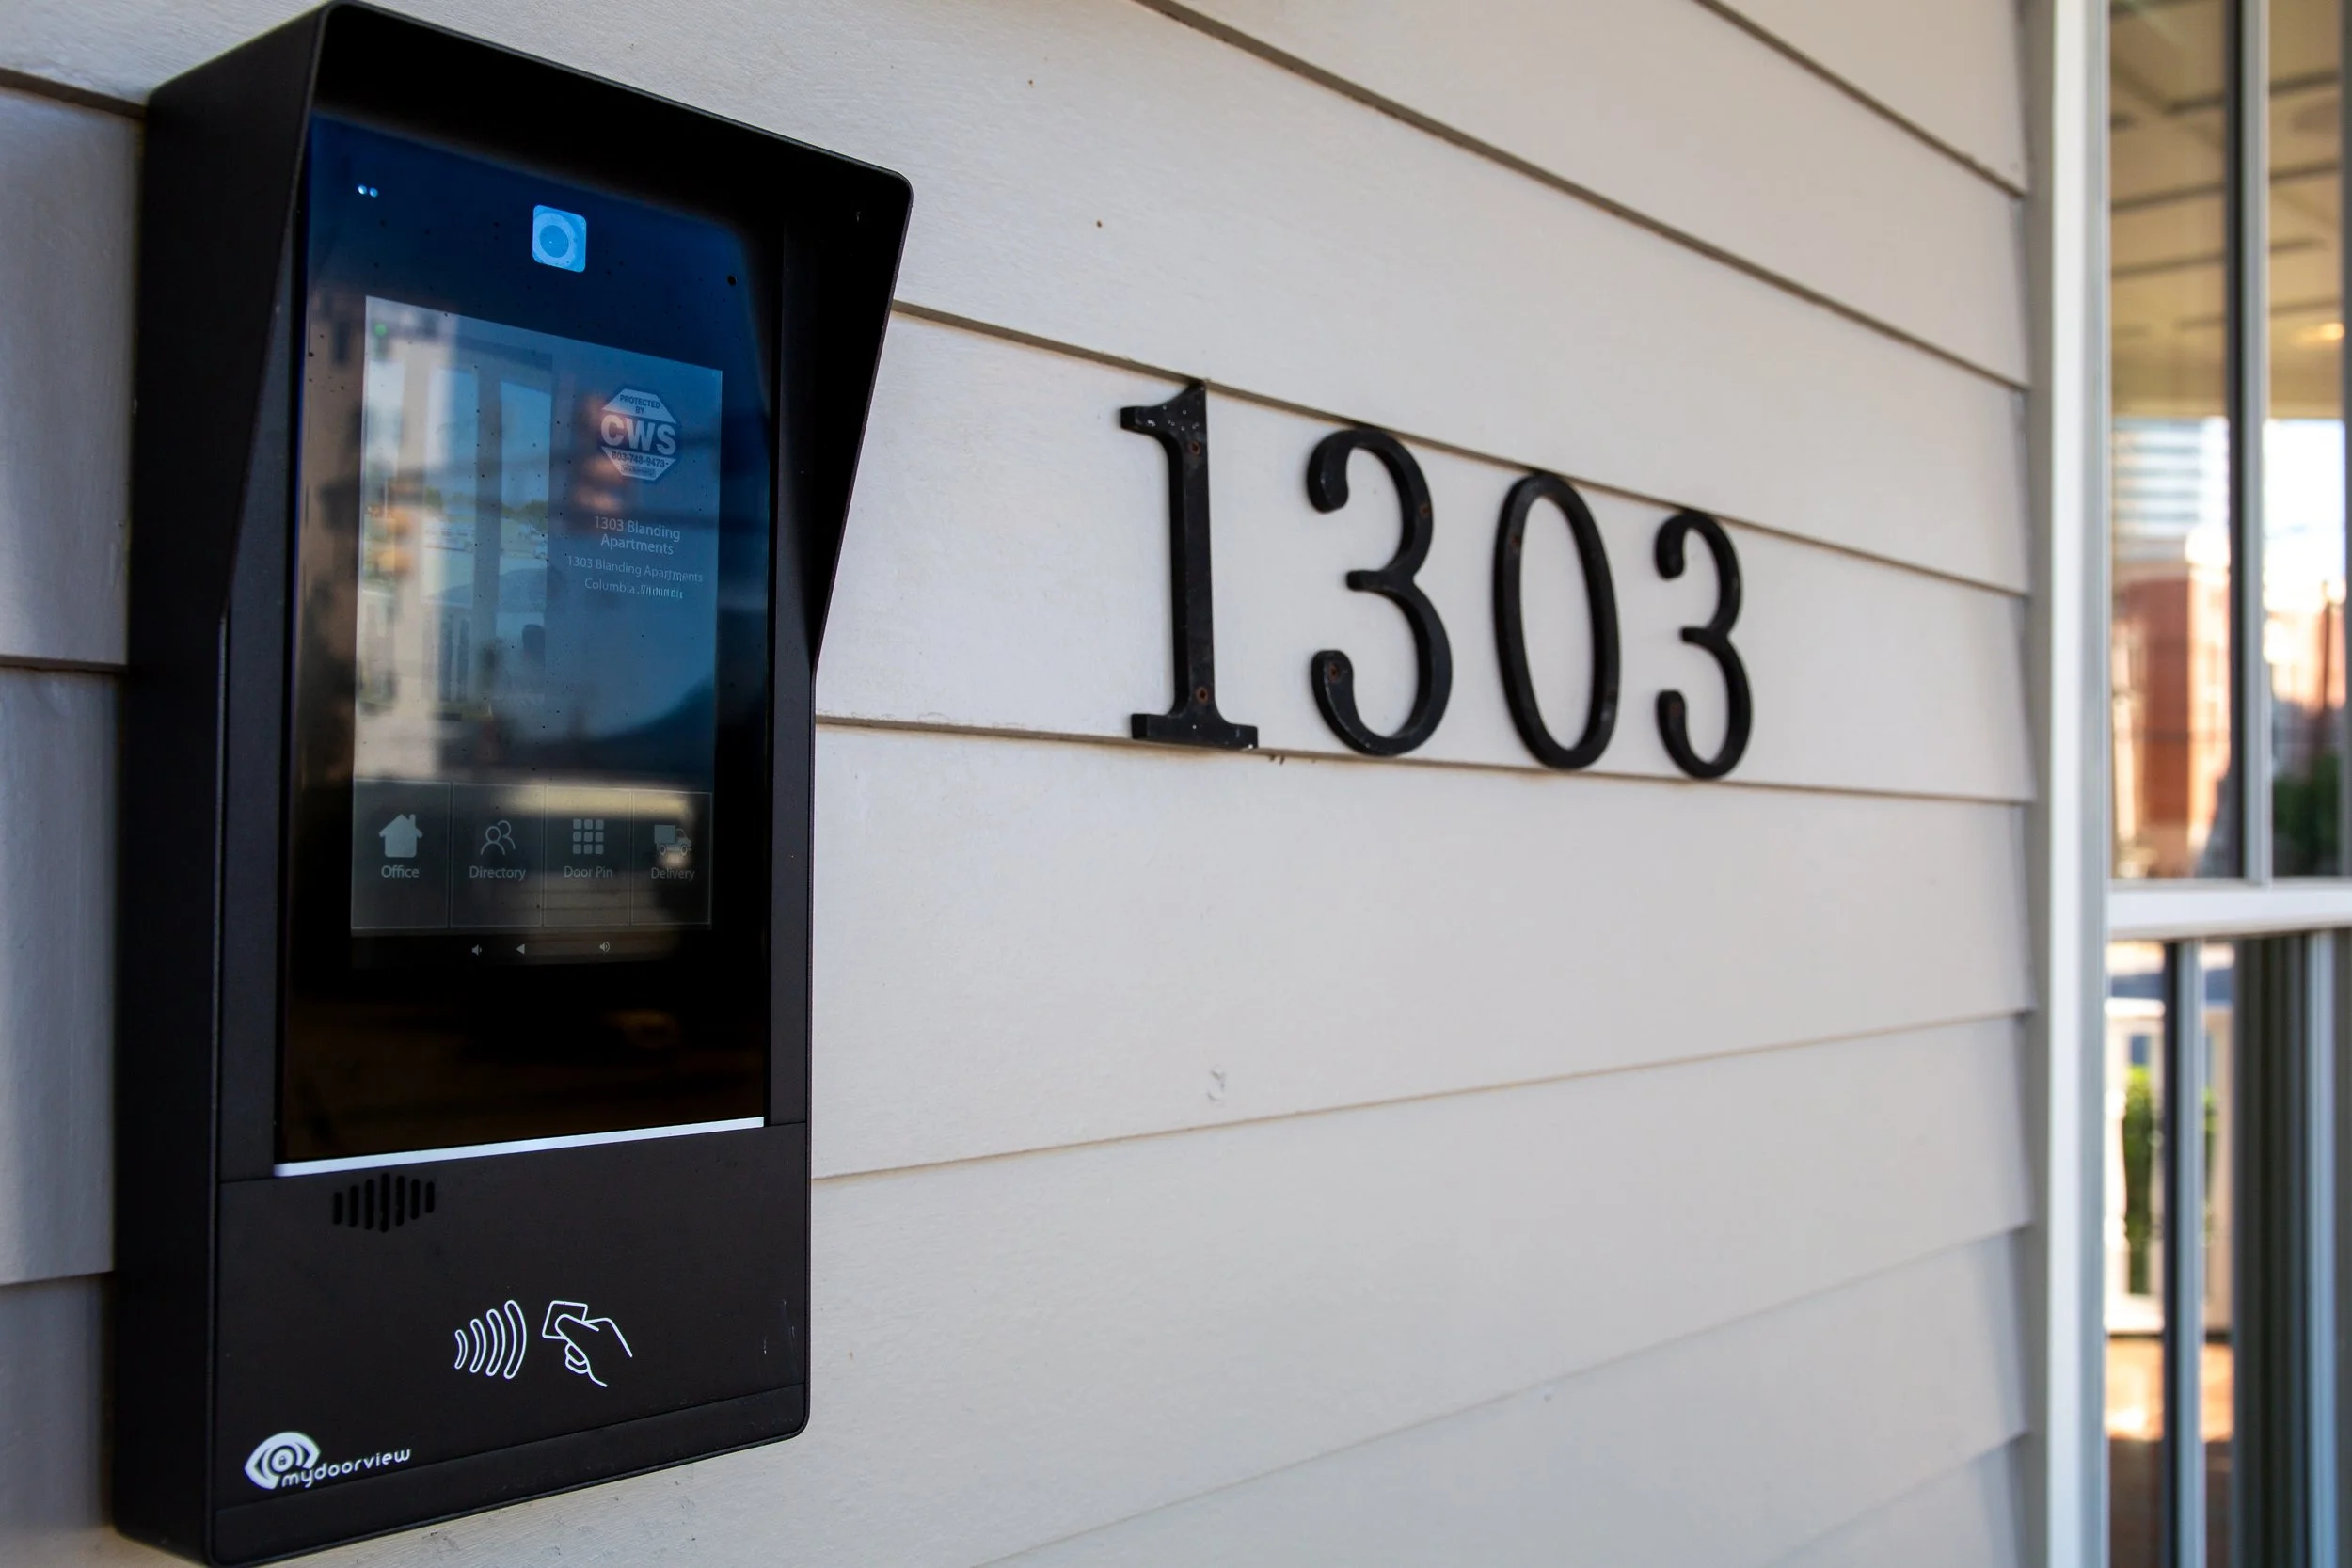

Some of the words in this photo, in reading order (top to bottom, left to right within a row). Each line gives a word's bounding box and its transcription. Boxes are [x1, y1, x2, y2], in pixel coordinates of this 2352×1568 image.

[619, 395, 660, 409] PROTECTED
[601, 415, 676, 455] CWS
[595, 516, 624, 531] 1303
[627, 520, 680, 542] Blanding
[600, 534, 674, 555] Apartments
[568, 556, 593, 568] 1303
[596, 559, 642, 578] Blanding
[644, 565, 703, 582] Apartments
[584, 578, 635, 594] Columbia
[1120, 379, 1753, 781] 1303
[381, 865, 420, 878] Office
[469, 865, 526, 881] Directory
[564, 865, 593, 878] Door
[596, 866, 613, 878] Pin
[651, 867, 695, 881] Delivery
[281, 1449, 411, 1488] mydoorview
